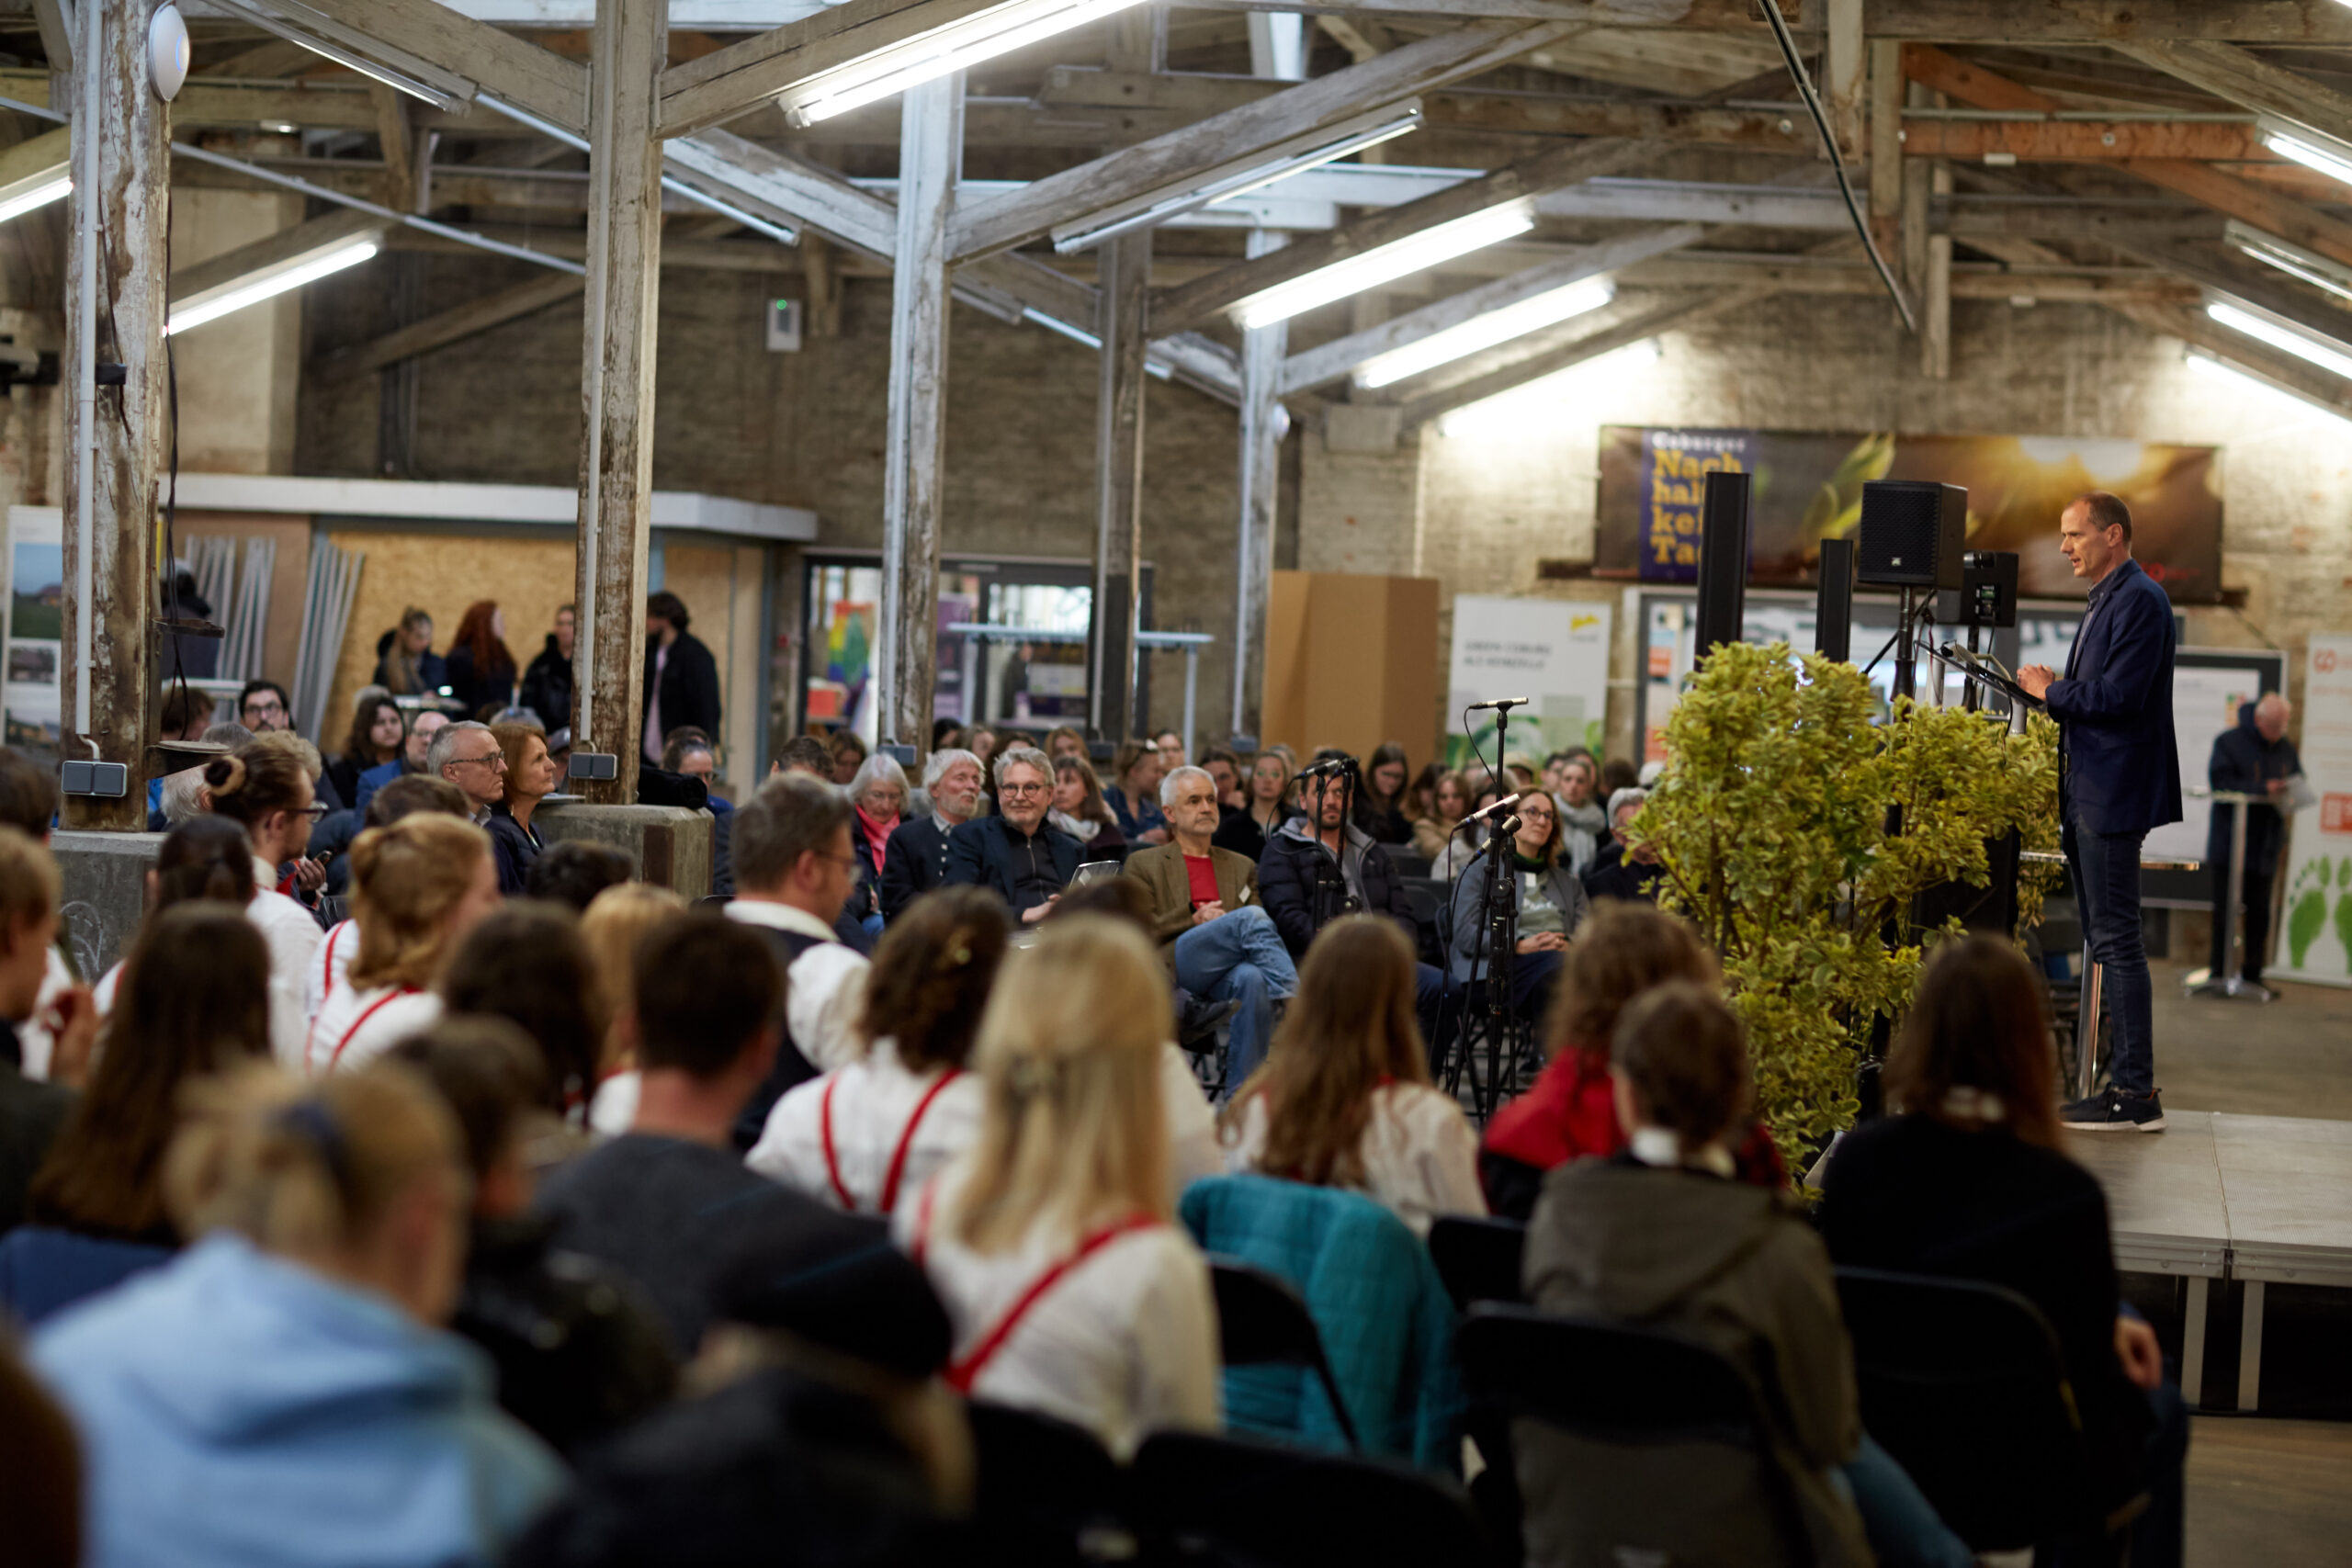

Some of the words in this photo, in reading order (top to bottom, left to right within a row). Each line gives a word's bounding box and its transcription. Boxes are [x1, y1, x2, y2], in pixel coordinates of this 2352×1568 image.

[1653, 448, 1743, 479] Nach
[1651, 479, 1705, 504] hal
[1650, 535, 1702, 565] Ta
